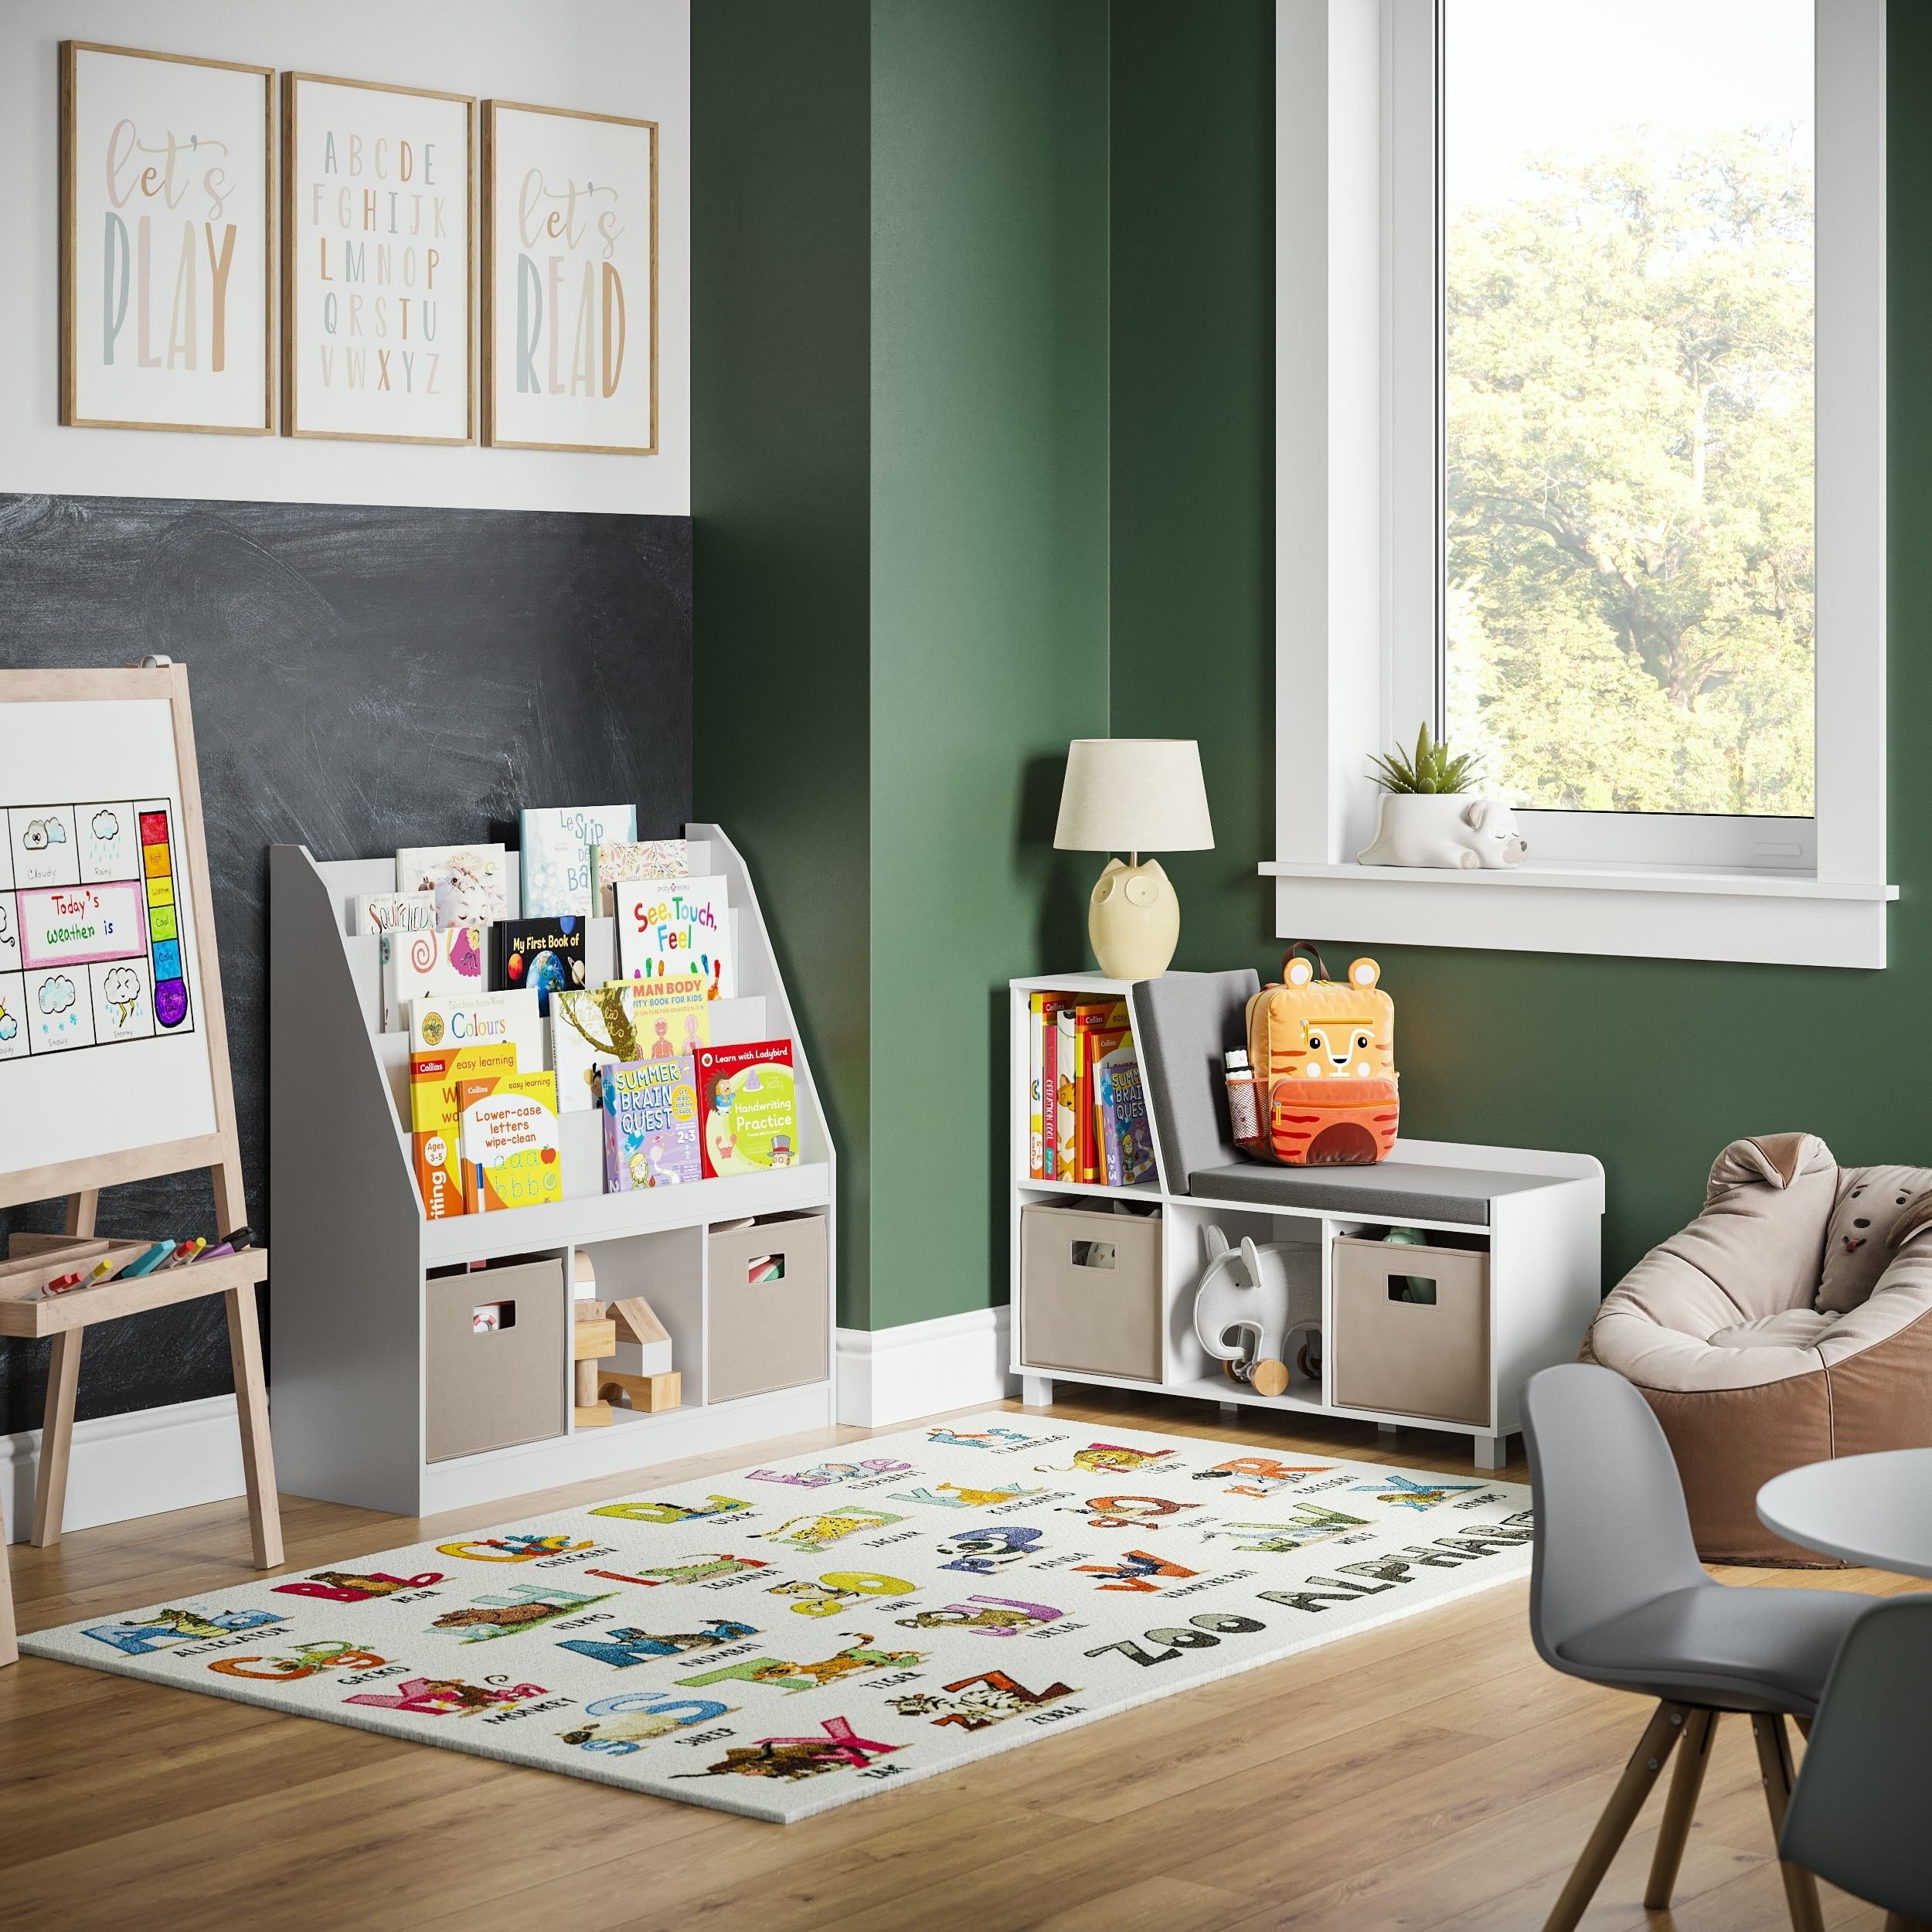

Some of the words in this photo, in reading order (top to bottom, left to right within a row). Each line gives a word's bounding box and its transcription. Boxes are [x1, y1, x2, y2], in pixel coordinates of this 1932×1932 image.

[106, 118, 236, 221] let's
[519, 168, 624, 260] let's
[104, 212, 237, 372] PLAY
[516, 253, 625, 399] READ
[27, 867, 56, 883] Cloudy
[94, 867, 112, 878] Rainy
[566, 865, 589, 892] Ba
[51, 890, 100, 920] Today's
[634, 903, 672, 932] See,
[672, 896, 717, 932] Touch,
[46, 923, 95, 944] weather
[104, 920, 114, 936] is
[155, 917, 169, 927] Cool
[513, 937, 525, 954] My
[526, 936, 547, 951] First
[548, 934, 569, 948] Book
[570, 933, 580, 946] of
[657, 924, 692, 952] Feel
[158, 951, 174, 962] Cold
[633, 983, 664, 998] MAN
[666, 980, 702, 995] BODY
[633, 999, 648, 1008] ITY
[649, 998, 669, 1006] BOOK
[672, 995, 685, 1004] FOR
[686, 994, 702, 1002] KIDS
[1046, 1003, 1065, 1012] Collins
[451, 1012, 505, 1039] Colours
[420, 1062, 443, 1073] Collins
[457, 1061, 476, 1071] easy
[479, 1056, 514, 1067] learning
[715, 1053, 736, 1063] Learn
[738, 1051, 754, 1061] with
[755, 1046, 788, 1060] Ladybird
[468, 1086, 488, 1094] Collins
[525, 1078, 550, 1087] learning
[616, 1063, 679, 1090] SUMMER
[1112, 1070, 1141, 1087] SUMM
[621, 1086, 672, 1111] BRAIN
[1115, 1087, 1144, 1103] BRAI
[476, 1106, 542, 1121] Lower-case
[735, 1100, 791, 1114] Handwriting
[1116, 1102, 1145, 1120] QUES
[490, 1121, 529, 1134] letters
[621, 1108, 673, 1134] QUEST
[736, 1114, 792, 1132] Practice
[427, 1142, 444, 1151] Ages
[485, 1133, 536, 1148] wipe-clean
[429, 1171, 447, 1219] iting
[391, 1590, 446, 1604] BEAR
[1083, 1613, 1267, 1667] ZOO
[1255, 1509, 1534, 1613] ALPHAB
[551, 1612, 615, 1631] HIPPO
[172, 1627, 295, 1658] ALLIGATOR
[337, 1665, 411, 1686] GECKO
[481, 1696, 577, 1726] MONKEY
[1023, 1703, 1088, 1725] ZEBRA
